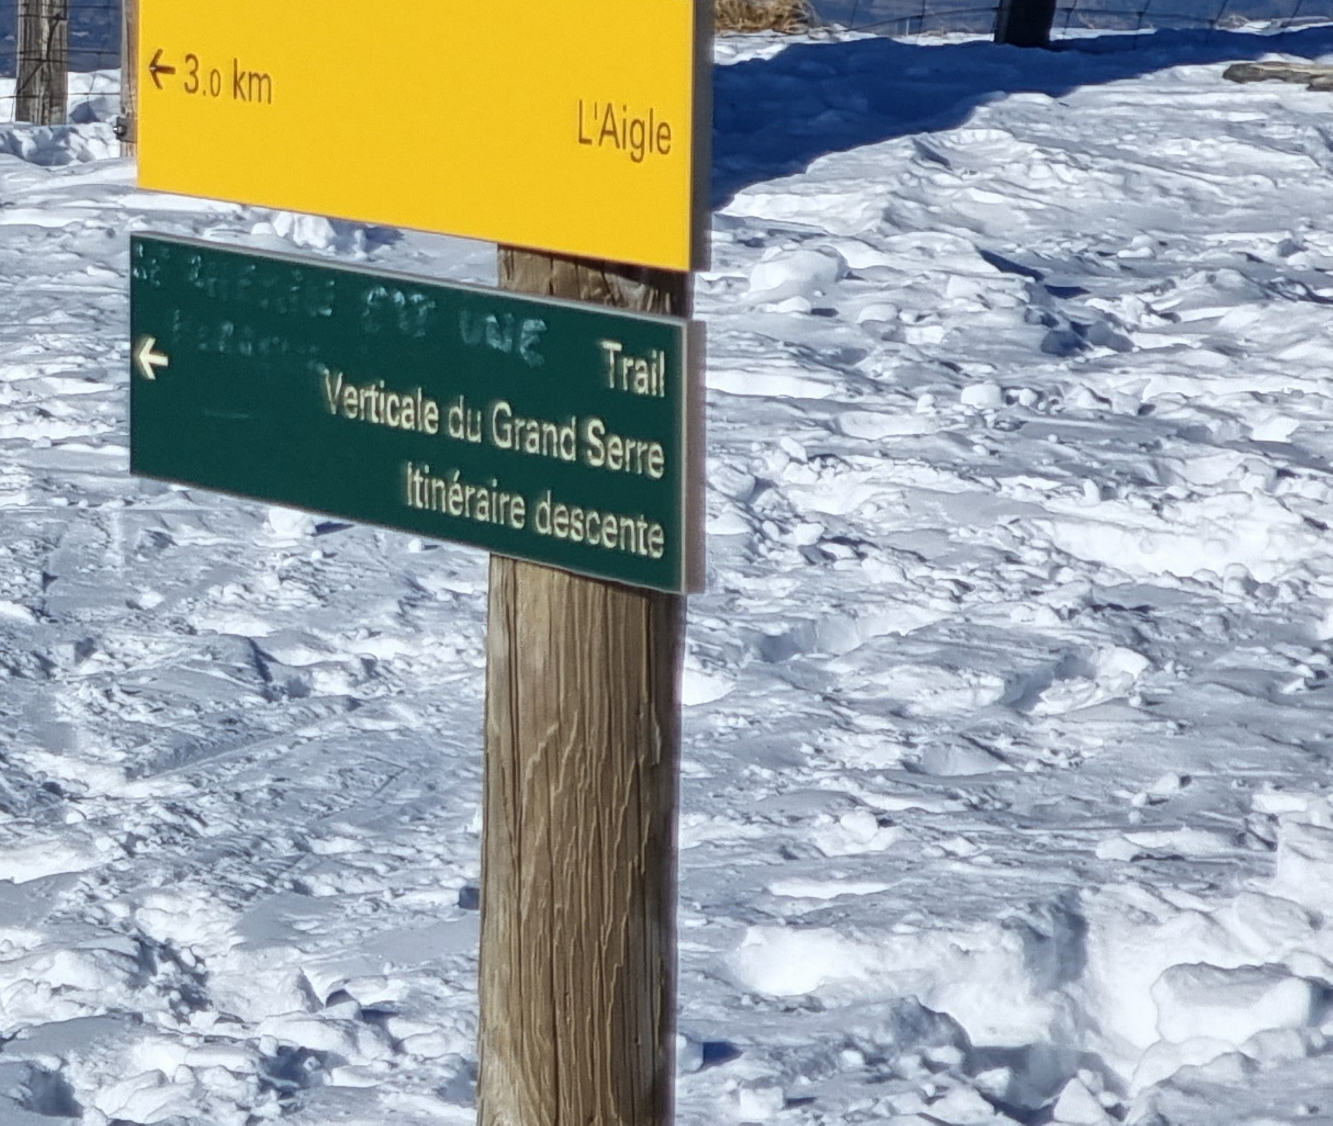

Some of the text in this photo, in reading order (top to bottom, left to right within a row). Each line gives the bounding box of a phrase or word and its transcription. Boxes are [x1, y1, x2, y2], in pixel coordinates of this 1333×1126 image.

[183, 53, 672, 163] 3.0 km L'Aigle
[598, 340, 665, 398] Trail
[322, 368, 665, 479] Verticale du Grand Serre
[405, 461, 665, 559] Itinéraire descente
